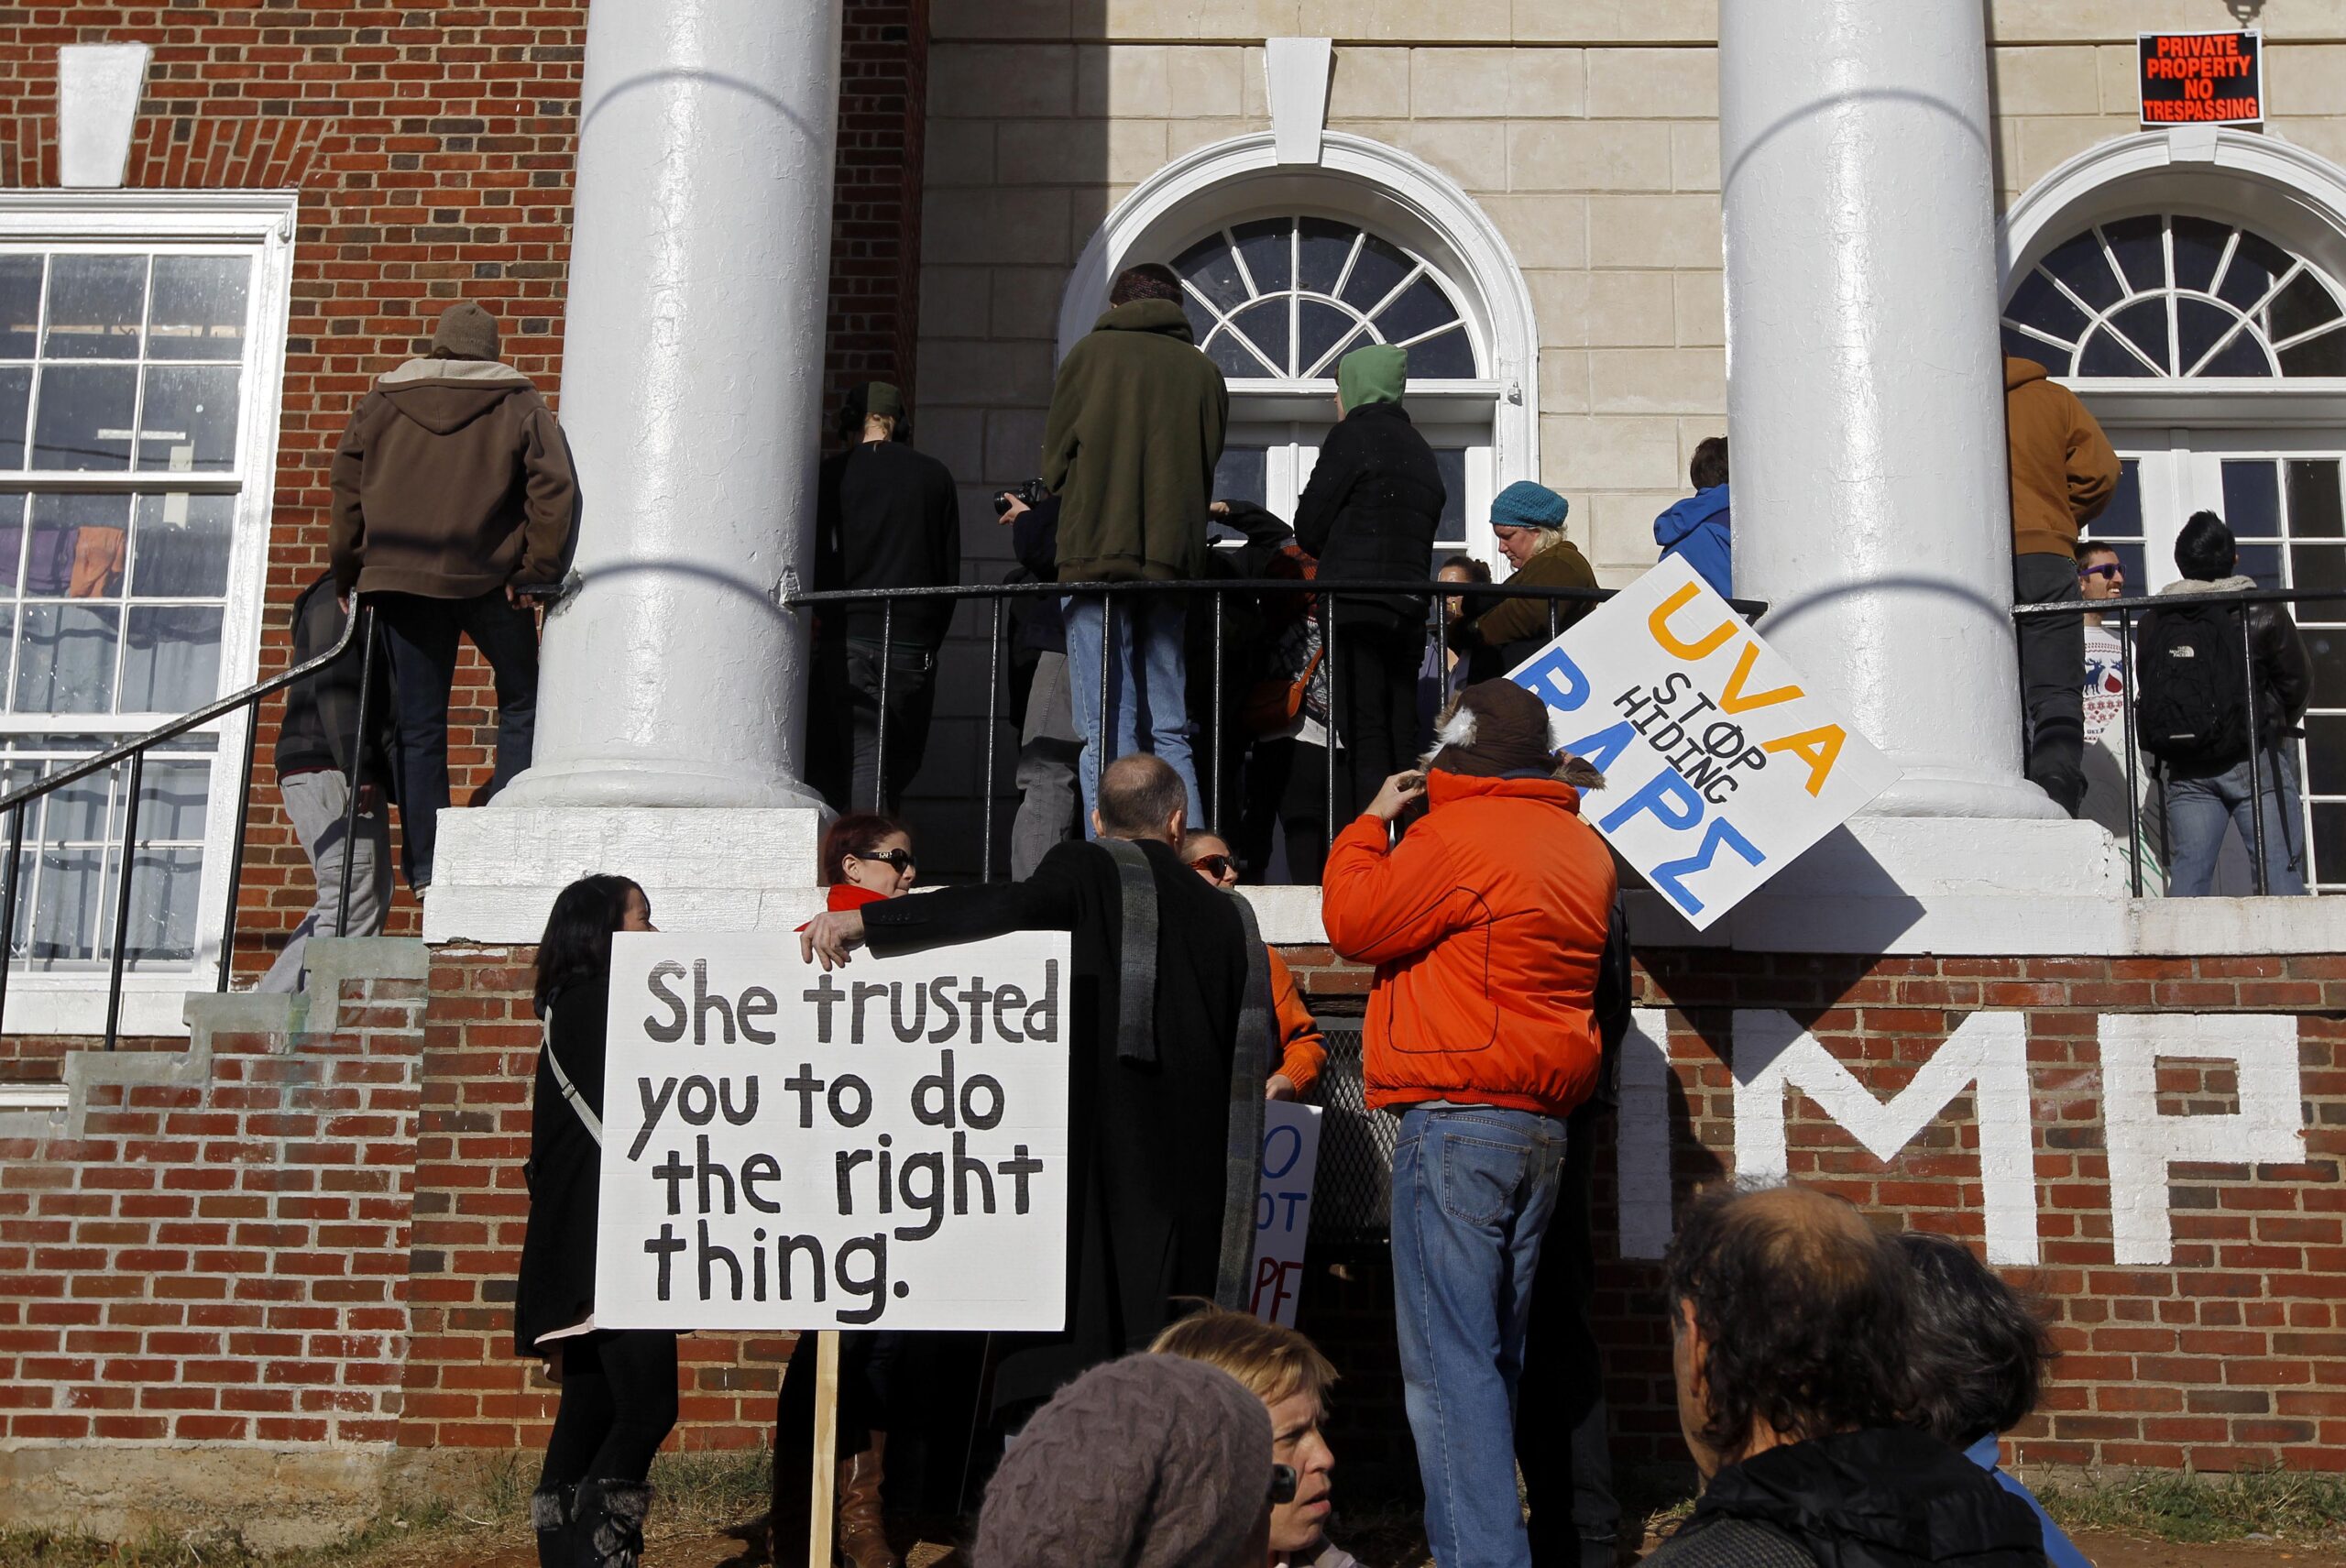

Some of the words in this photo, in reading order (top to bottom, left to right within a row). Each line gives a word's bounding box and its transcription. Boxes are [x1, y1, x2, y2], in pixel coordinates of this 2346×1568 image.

[2146, 55, 2252, 79] PROPERTY
[2156, 35, 2239, 57] PRIVATE
[2184, 78, 2214, 99] NO
[2143, 96, 2258, 121] TRESPASSING
[1648, 580, 1847, 798] UVA
[1613, 685, 1739, 805] HIDING
[642, 958, 778, 1046] She
[803, 958, 1058, 1045] trusted
[627, 1074, 759, 1162] you
[784, 1063, 872, 1129] to
[910, 1049, 1005, 1131] do
[652, 1134, 782, 1216] the
[835, 1130, 1044, 1242] right
[643, 1218, 910, 1325] thing.
